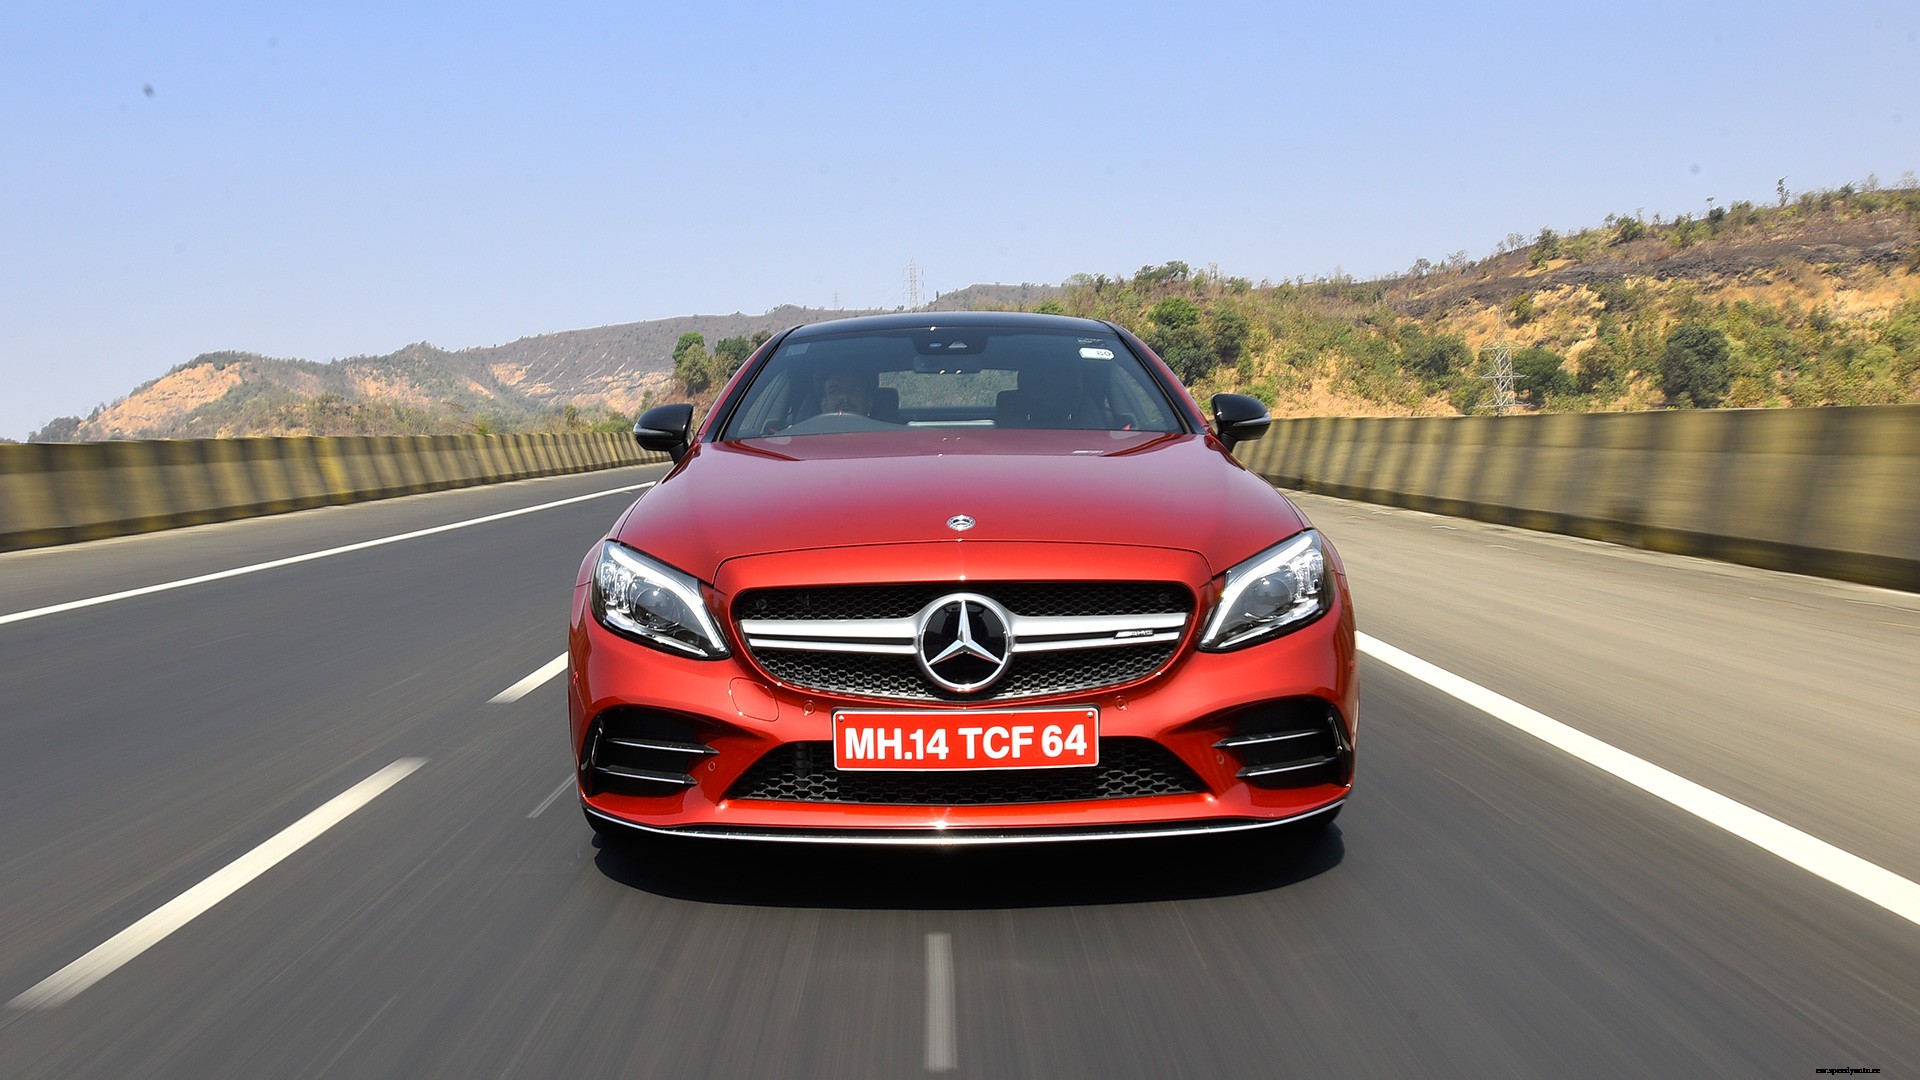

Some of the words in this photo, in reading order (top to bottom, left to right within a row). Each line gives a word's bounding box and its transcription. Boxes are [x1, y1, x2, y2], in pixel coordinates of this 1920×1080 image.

[845, 727, 950, 760] MH.14
[958, 725, 1034, 760] TCF
[1041, 723, 1087, 758] 64
